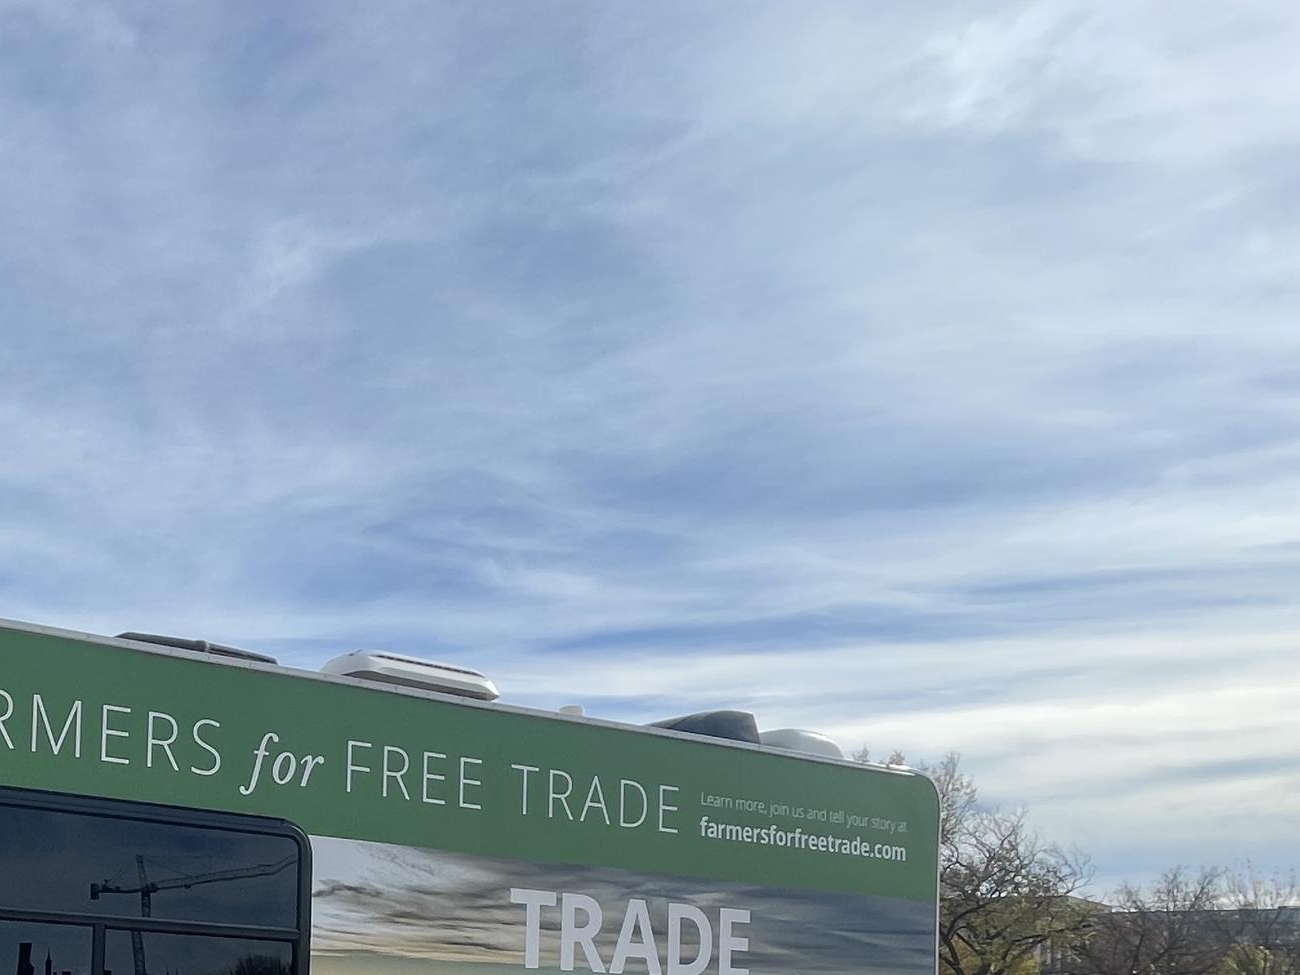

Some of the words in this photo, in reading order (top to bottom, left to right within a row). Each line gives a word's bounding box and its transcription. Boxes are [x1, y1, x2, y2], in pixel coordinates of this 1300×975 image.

[239, 732, 325, 797] for
[345, 739, 484, 811] FREE
[510, 763, 681, 834] TRADE
[700, 791, 733, 808] Learn
[735, 799, 767, 814] more,
[769, 804, 790, 818] join
[792, 807, 805, 818] us
[806, 807, 827, 822] and
[829, 810, 844, 824] tell
[846, 814, 868, 829] your
[871, 817, 896, 834] story
[699, 816, 908, 862] farmersforfreetrade.com
